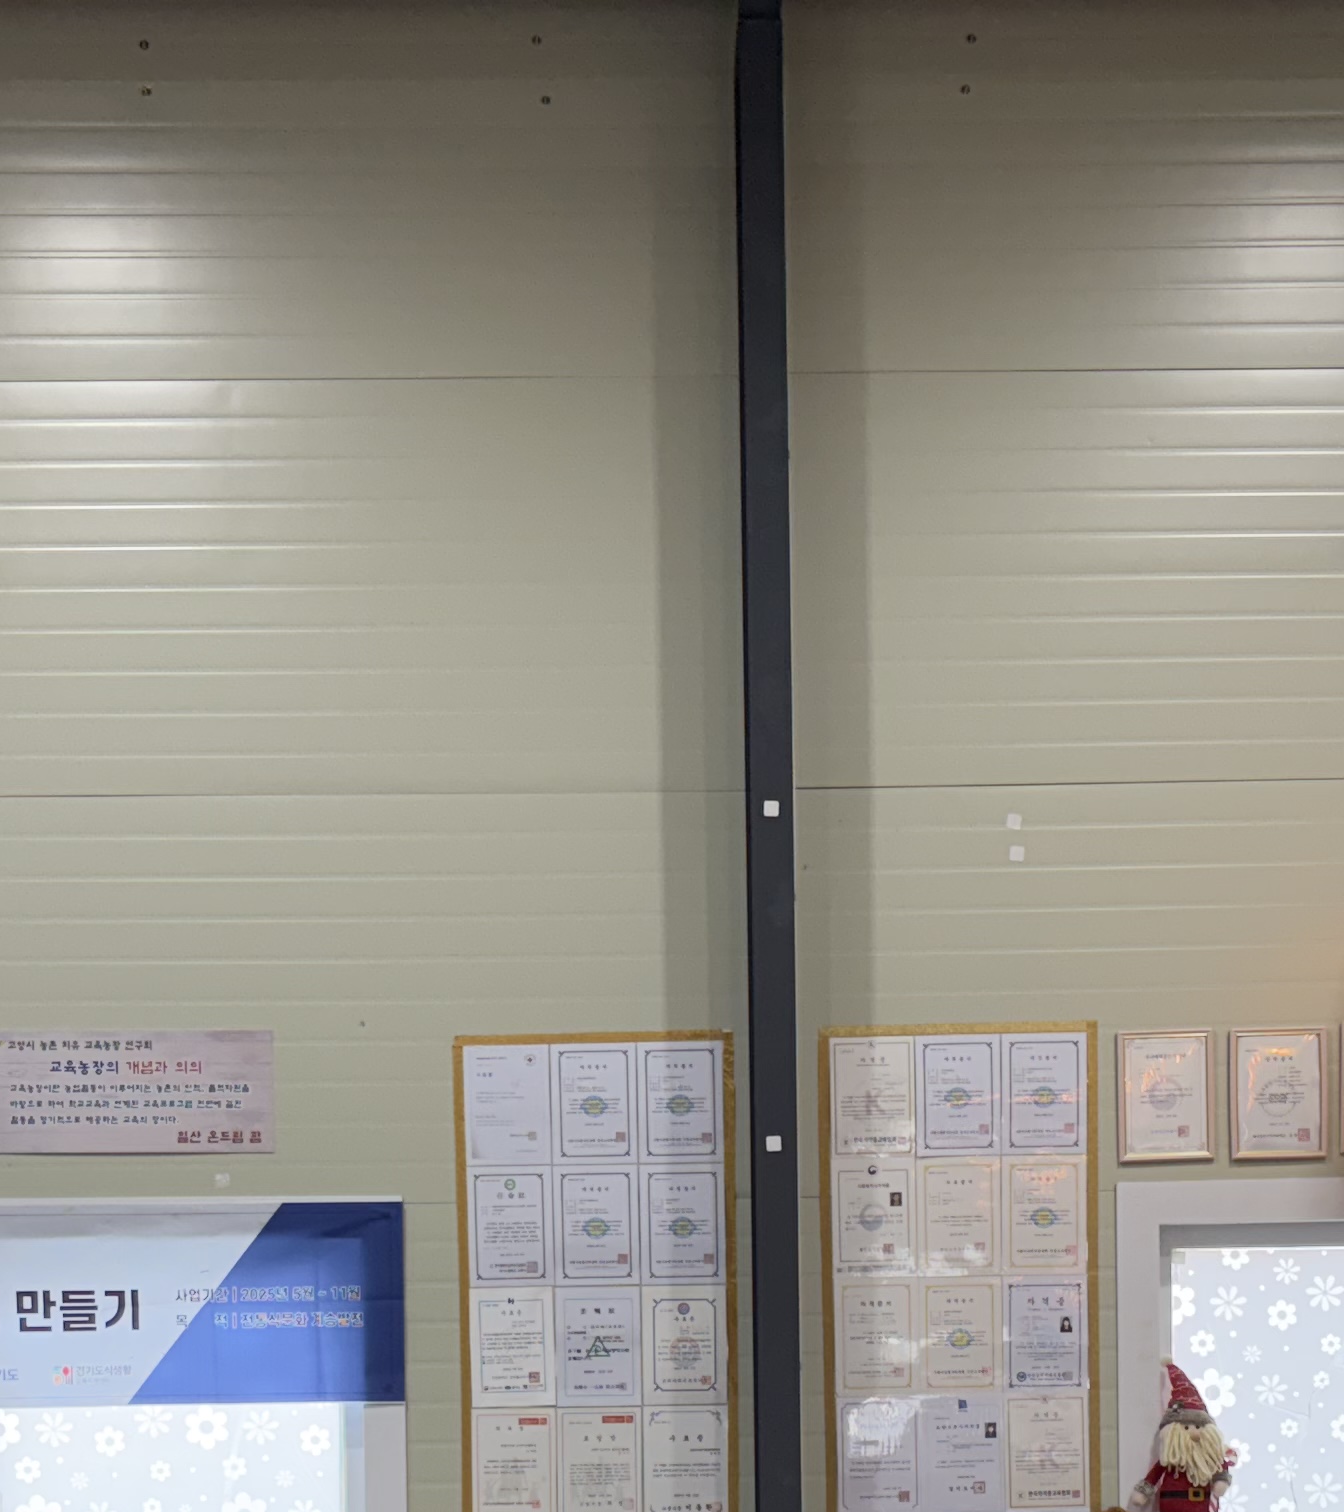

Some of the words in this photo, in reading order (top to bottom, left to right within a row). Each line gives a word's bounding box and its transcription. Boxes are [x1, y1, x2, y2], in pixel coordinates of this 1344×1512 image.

[8, 1040, 34, 1050] 고양시
[62, 1040, 78, 1050] 치유
[84, 1040, 120, 1050] 교육농장
[125, 1040, 152, 1050] 연구회
[50, 1061, 118, 1074] 교육농장의
[126, 1061, 167, 1074] 개념과
[176, 1060, 202, 1074] 의의
[110, 1084, 151, 1093] 이루어지는
[178, 1130, 201, 1144] 일산
[208, 1130, 243, 1144] 온드림
[176, 1288, 228, 1302] 사업기간
[241, 1287, 288, 1301] 2025년
[292, 1286, 314, 1300] 5월
[331, 1286, 360, 1300] 11월
[16, 1290, 139, 1332] 만들기
[241, 1312, 308, 1328] 전통식문화
[312, 1312, 364, 1328] 계승발전
[76, 1364, 132, 1376] 경기도식생활
